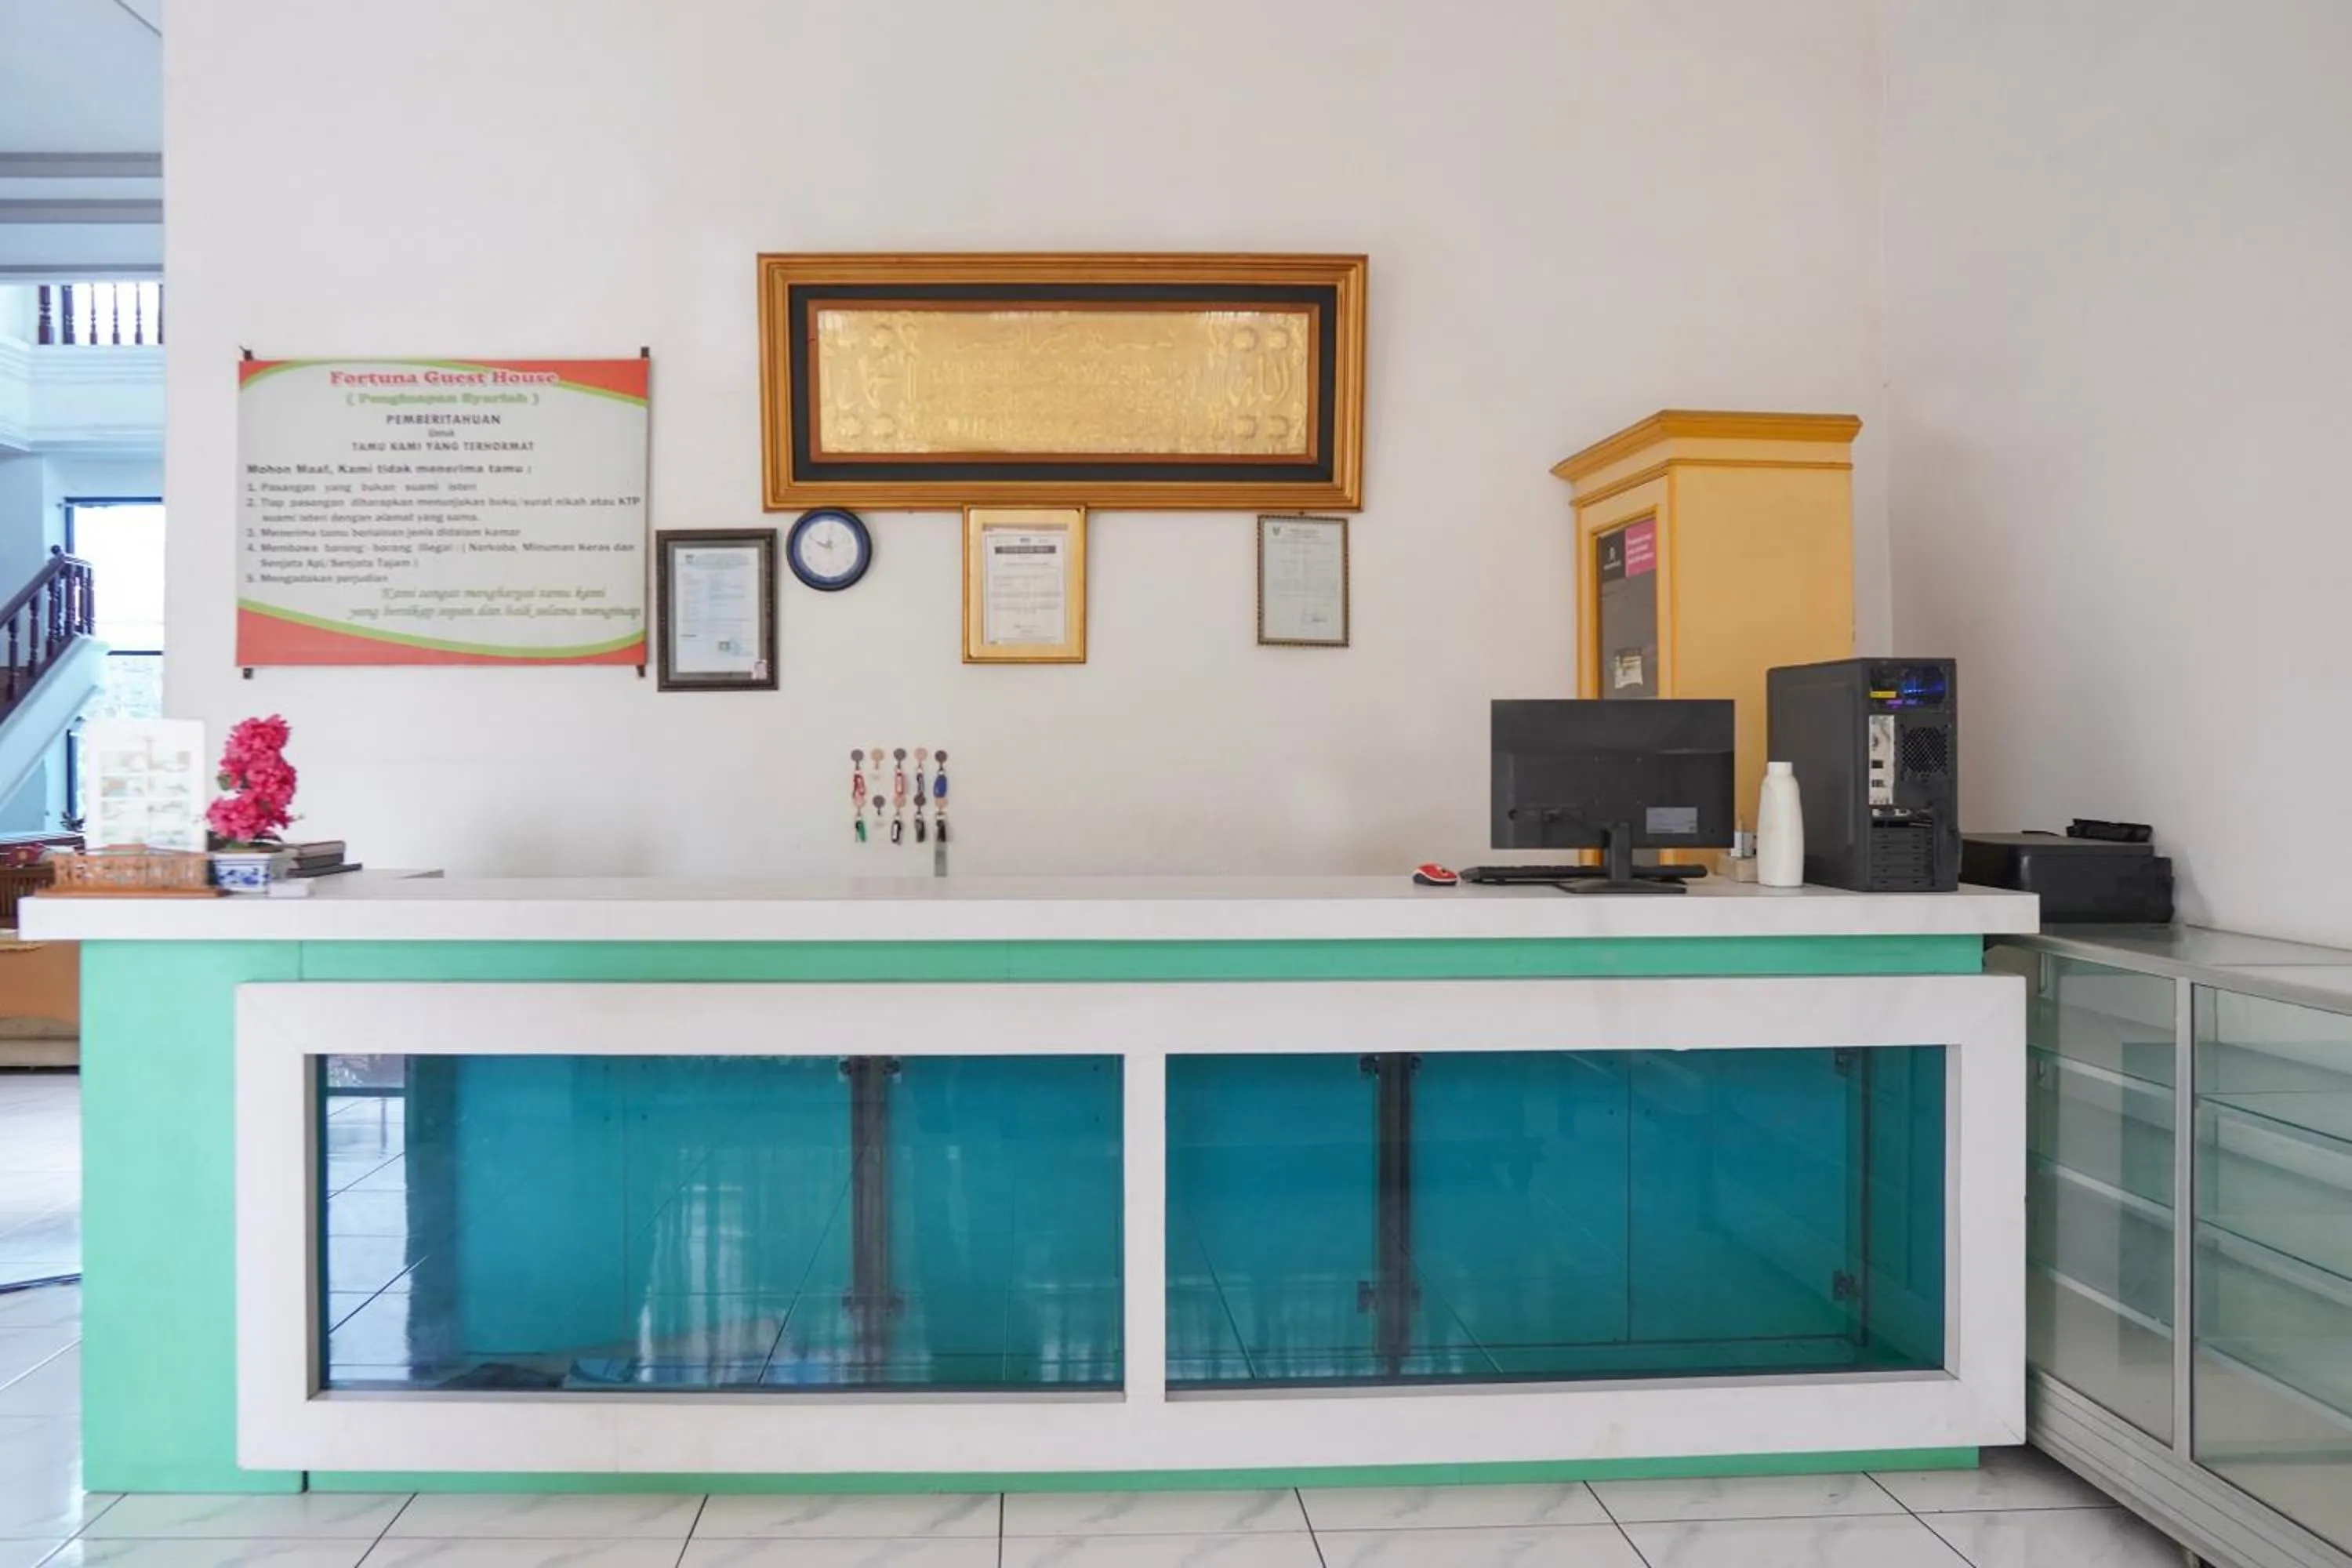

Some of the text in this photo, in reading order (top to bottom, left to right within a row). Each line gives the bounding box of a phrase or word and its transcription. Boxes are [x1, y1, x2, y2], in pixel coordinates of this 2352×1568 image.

[329, 371, 558, 385] Fortuna Guest House
[358, 393, 458, 406] Penginapan
[463, 393, 528, 406] Syariah
[386, 414, 502, 426] PEMBERITAHUAN
[352, 441, 535, 452] TAMU KAMI YANG TERHORMAT
[246, 464, 292, 474] Mohon
[296, 464, 334, 475] Maaf,
[338, 464, 373, 474] Kami
[377, 464, 412, 474] tidak
[416, 464, 485, 474] menerima
[488, 464, 524, 474] tamu
[261, 483, 317, 493] Pasangan
[325, 484, 352, 493] yang
[361, 483, 396, 492] bukan
[260, 497, 285, 508] Tiap
[289, 499, 346, 509] pasangan
[350, 497, 414, 508] diharapkan
[556, 496, 587, 506] nikah
[590, 497, 615, 506] atau
[618, 496, 641, 506] KTP
[262, 514, 296, 522] suami
[331, 513, 372, 524] dengan
[376, 514, 414, 522] alamat
[417, 514, 445, 524] yang
[485, 528, 521, 537] kamar
[613, 543, 635, 551] dan
